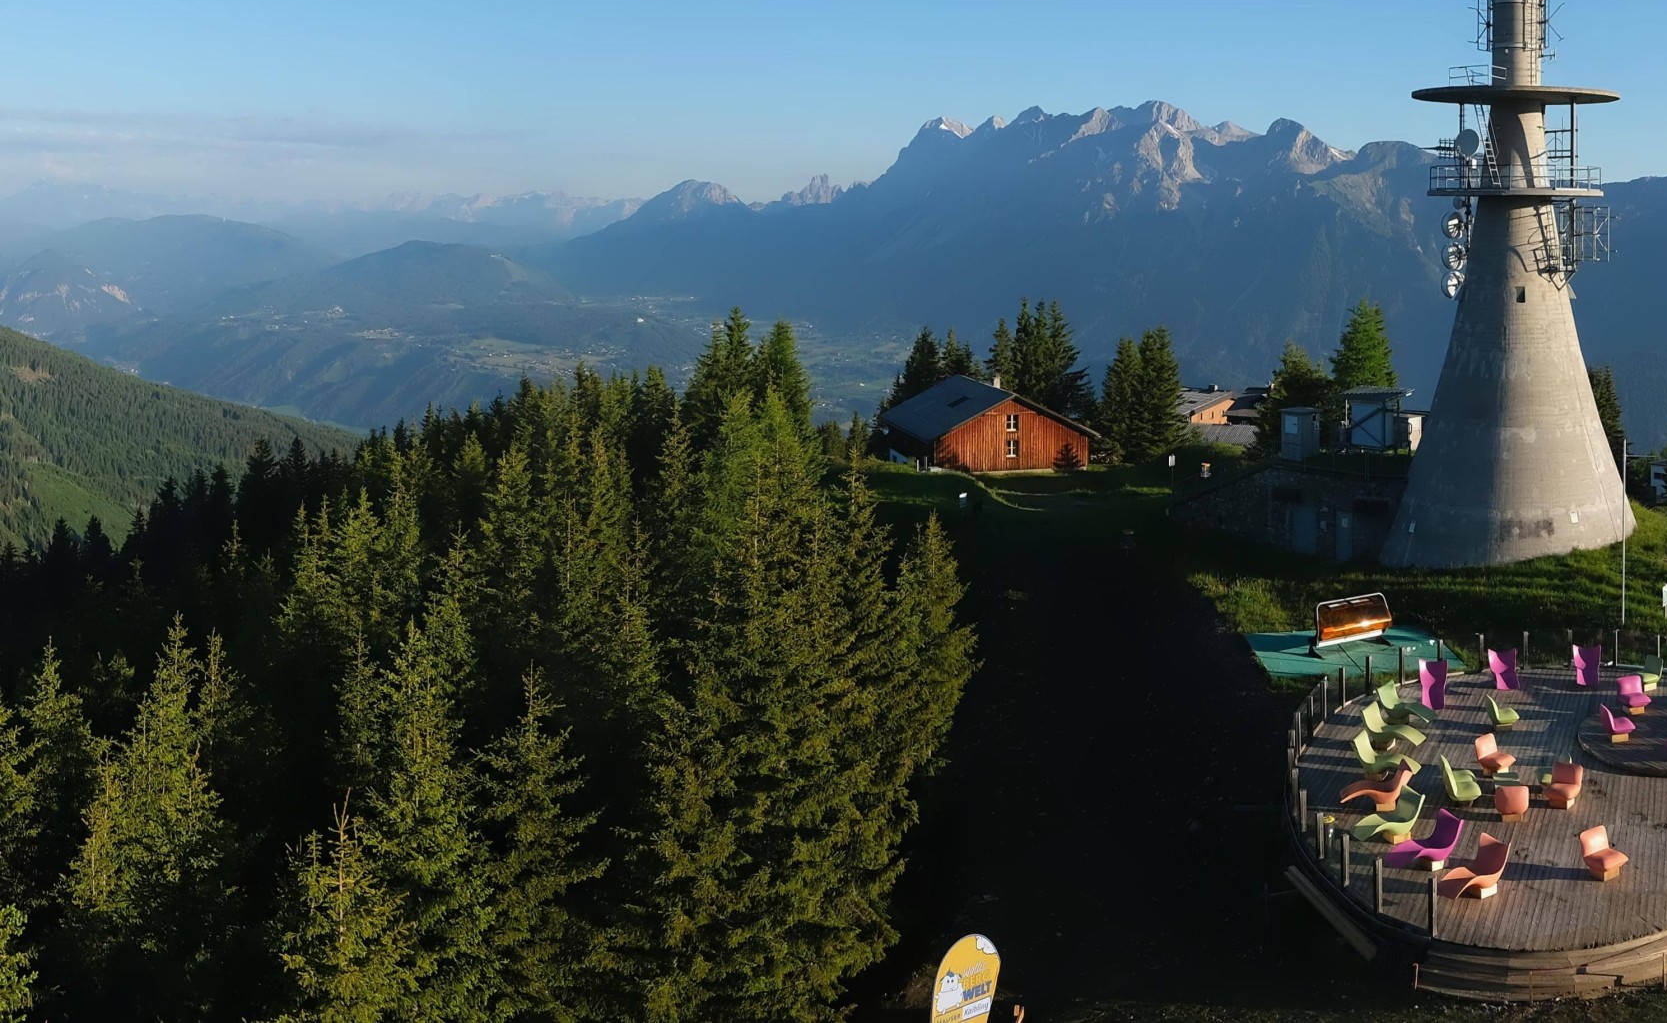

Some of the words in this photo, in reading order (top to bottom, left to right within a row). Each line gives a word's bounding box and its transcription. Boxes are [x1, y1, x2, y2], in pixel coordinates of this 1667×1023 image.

[964, 971, 990, 990] BERG
[963, 980, 991, 1001] WELT
[964, 1002, 989, 1016] Kaibling
